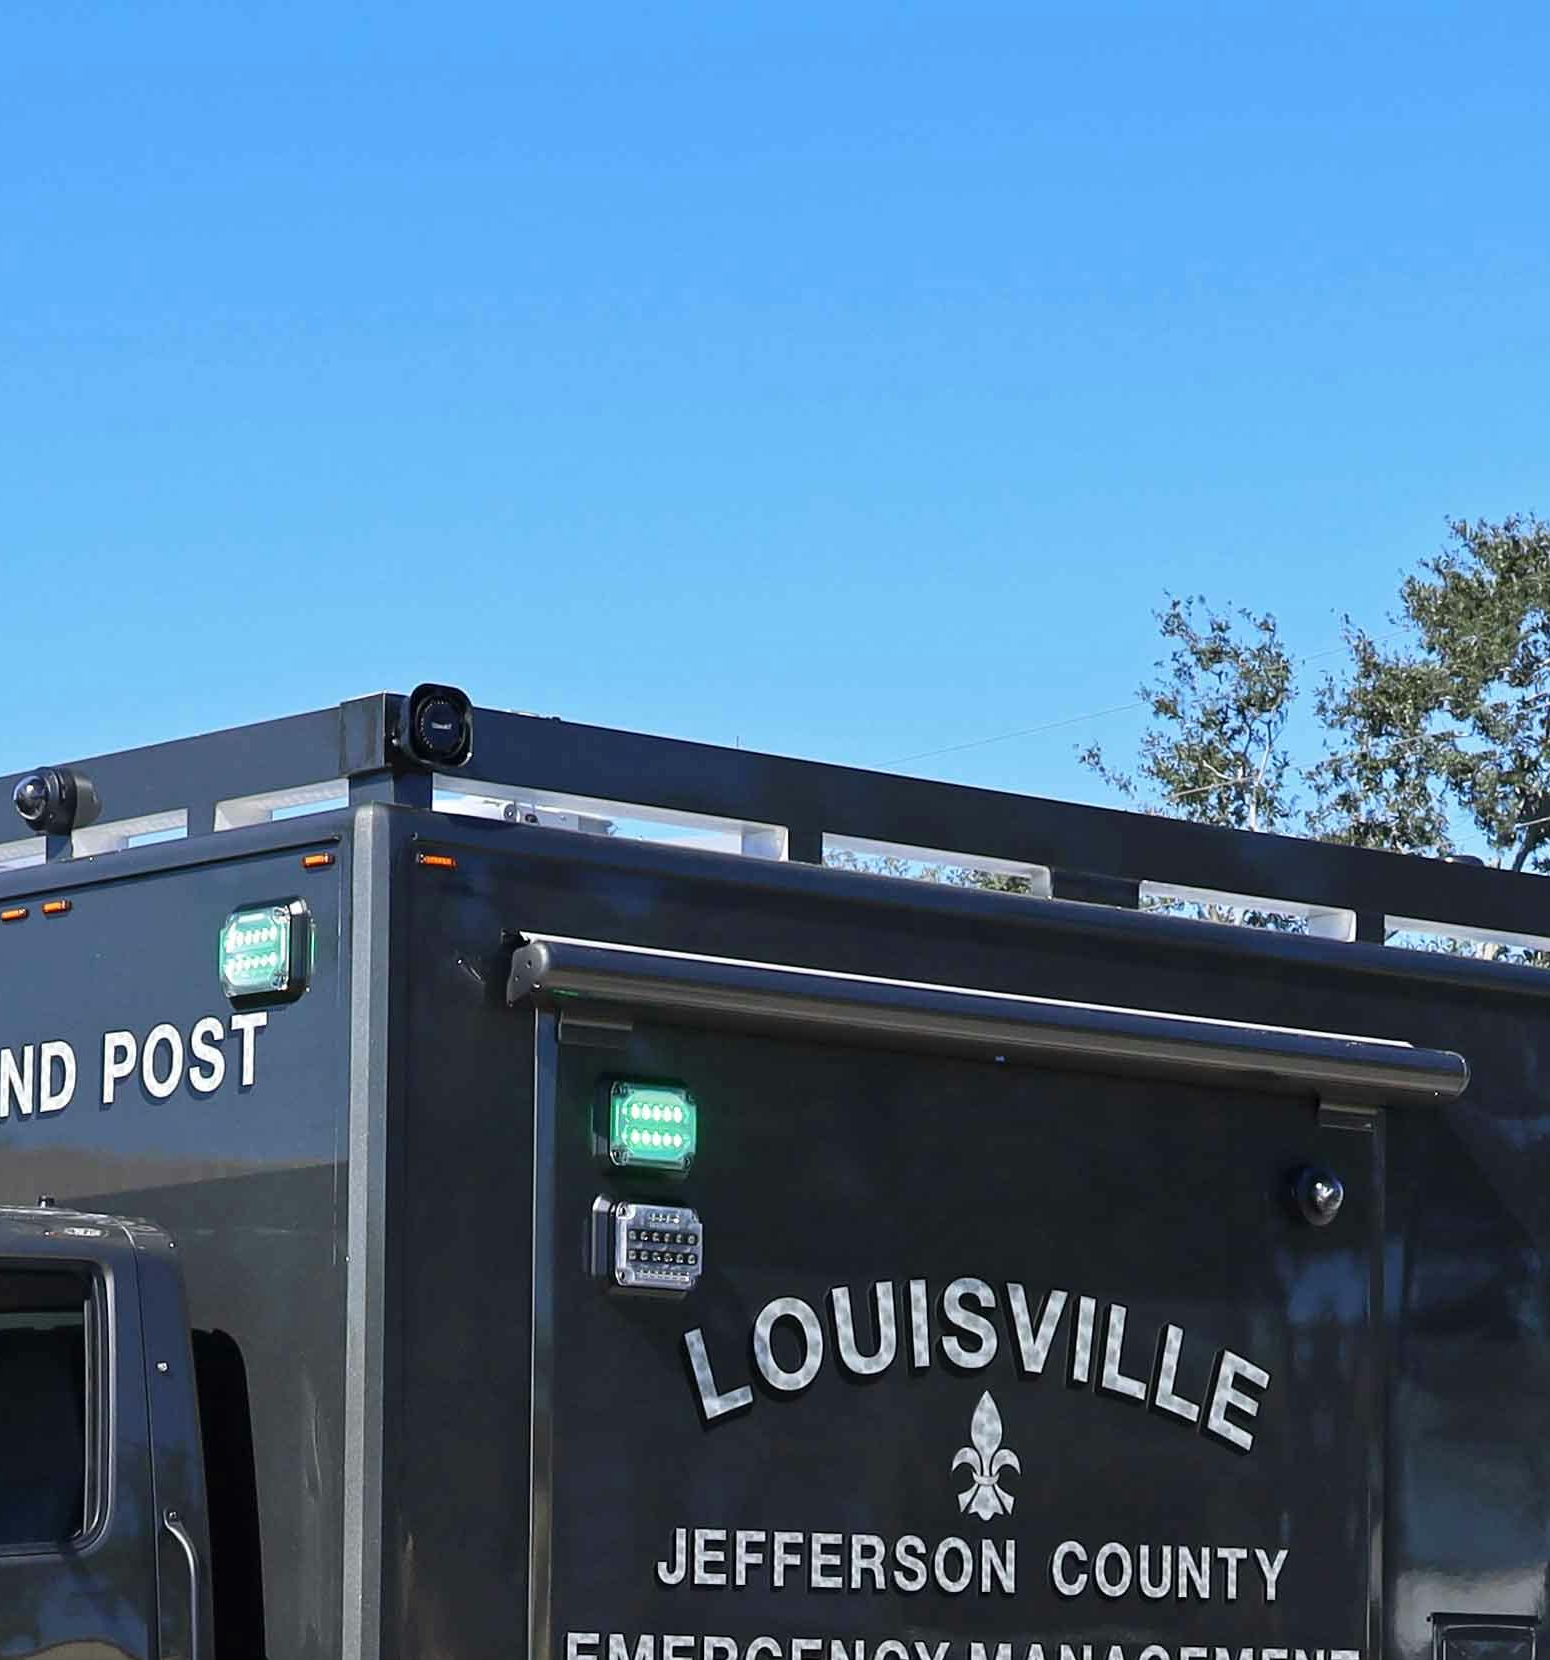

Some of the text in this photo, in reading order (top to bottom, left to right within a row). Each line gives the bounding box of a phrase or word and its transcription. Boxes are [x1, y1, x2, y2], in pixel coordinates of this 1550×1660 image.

[102, 1011, 268, 1104] POST
[684, 1277, 1272, 1451] LOUISVILLE
[657, 1527, 1289, 1601] JEFFERSON COUNTY
